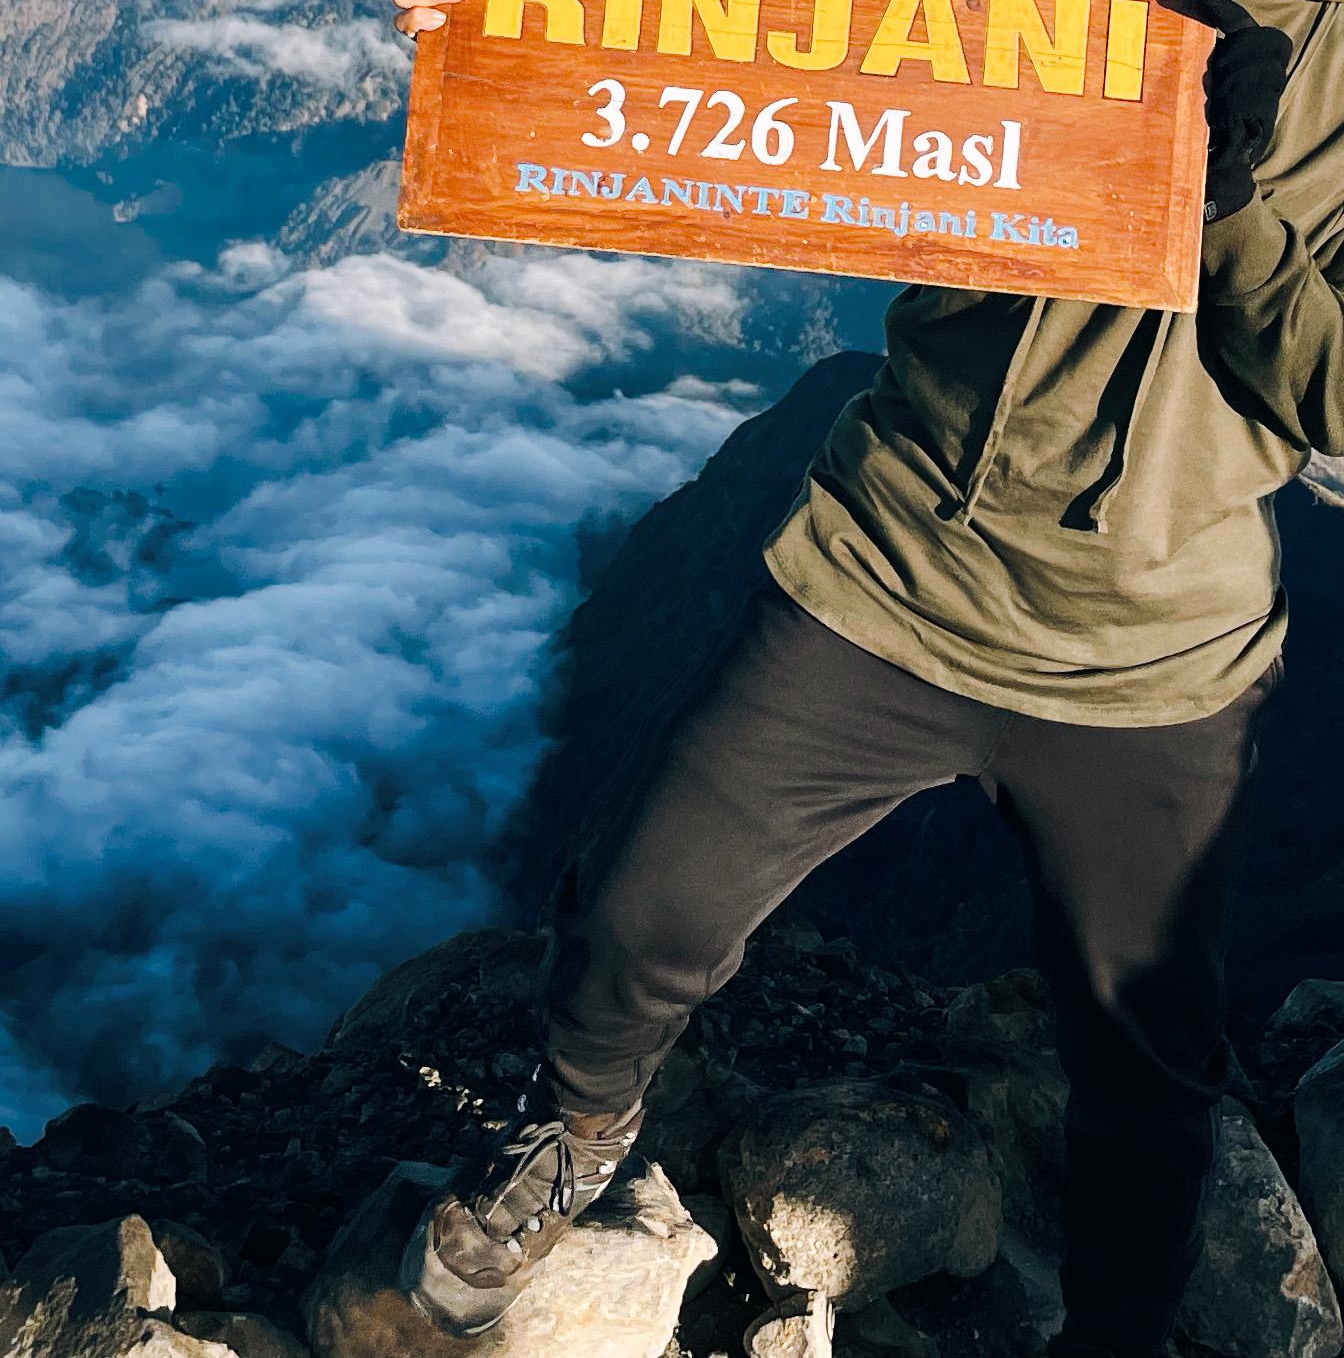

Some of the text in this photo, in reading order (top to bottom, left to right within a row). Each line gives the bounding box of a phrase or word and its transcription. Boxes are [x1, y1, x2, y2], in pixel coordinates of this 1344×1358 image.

[581, 79, 1023, 190] 3.726 Masl
[514, 161, 1080, 250] RINJANINTE Rinjani Kita
